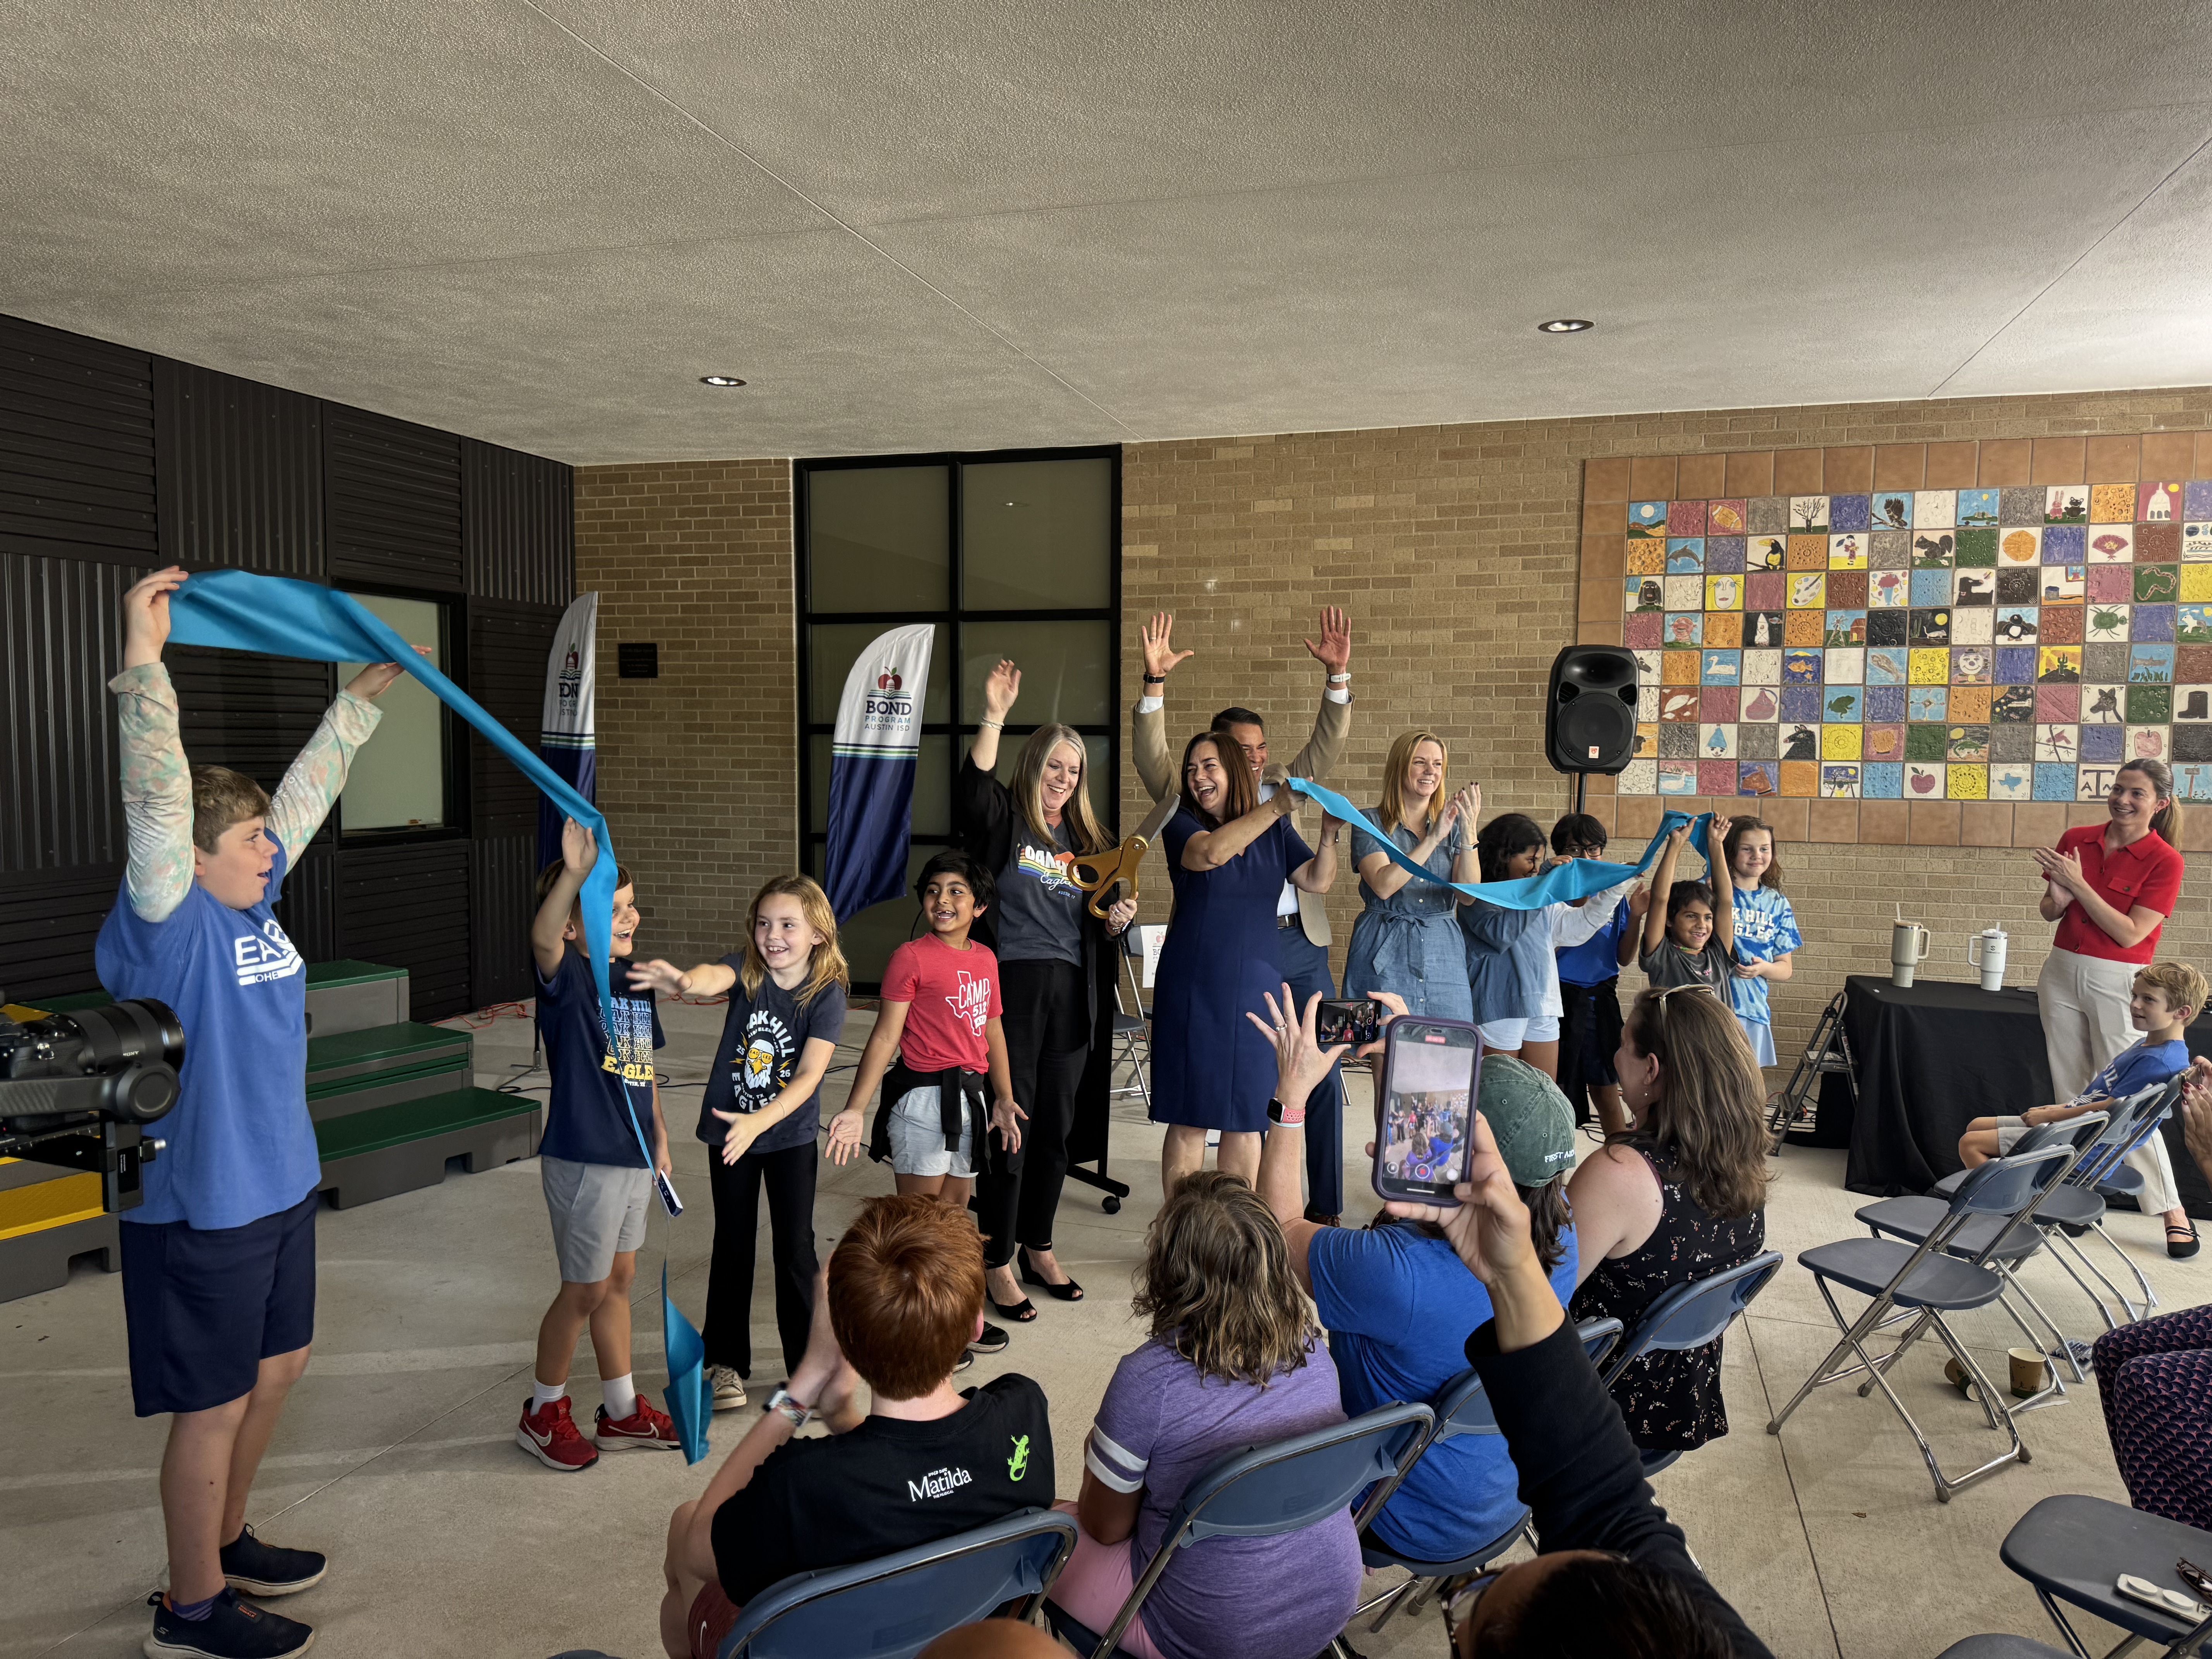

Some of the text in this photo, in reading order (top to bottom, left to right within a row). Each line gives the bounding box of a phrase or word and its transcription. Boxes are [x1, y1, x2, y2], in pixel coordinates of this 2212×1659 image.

[866, 701, 912, 715] BOND
[1745, 909, 1774, 927] HILL
[1734, 922, 1774, 941] GLES
[958, 978, 990, 1009] CAMP
[972, 1001, 987, 1017] 512
[769, 1016, 795, 1058] HILL
[736, 1045, 745, 1056] 25
[601, 1055, 654, 1080] EGLE
[780, 1069, 791, 1078] 26
[1544, 1151, 1564, 1163] FIRST
[908, 1467, 973, 1502] Matilda
